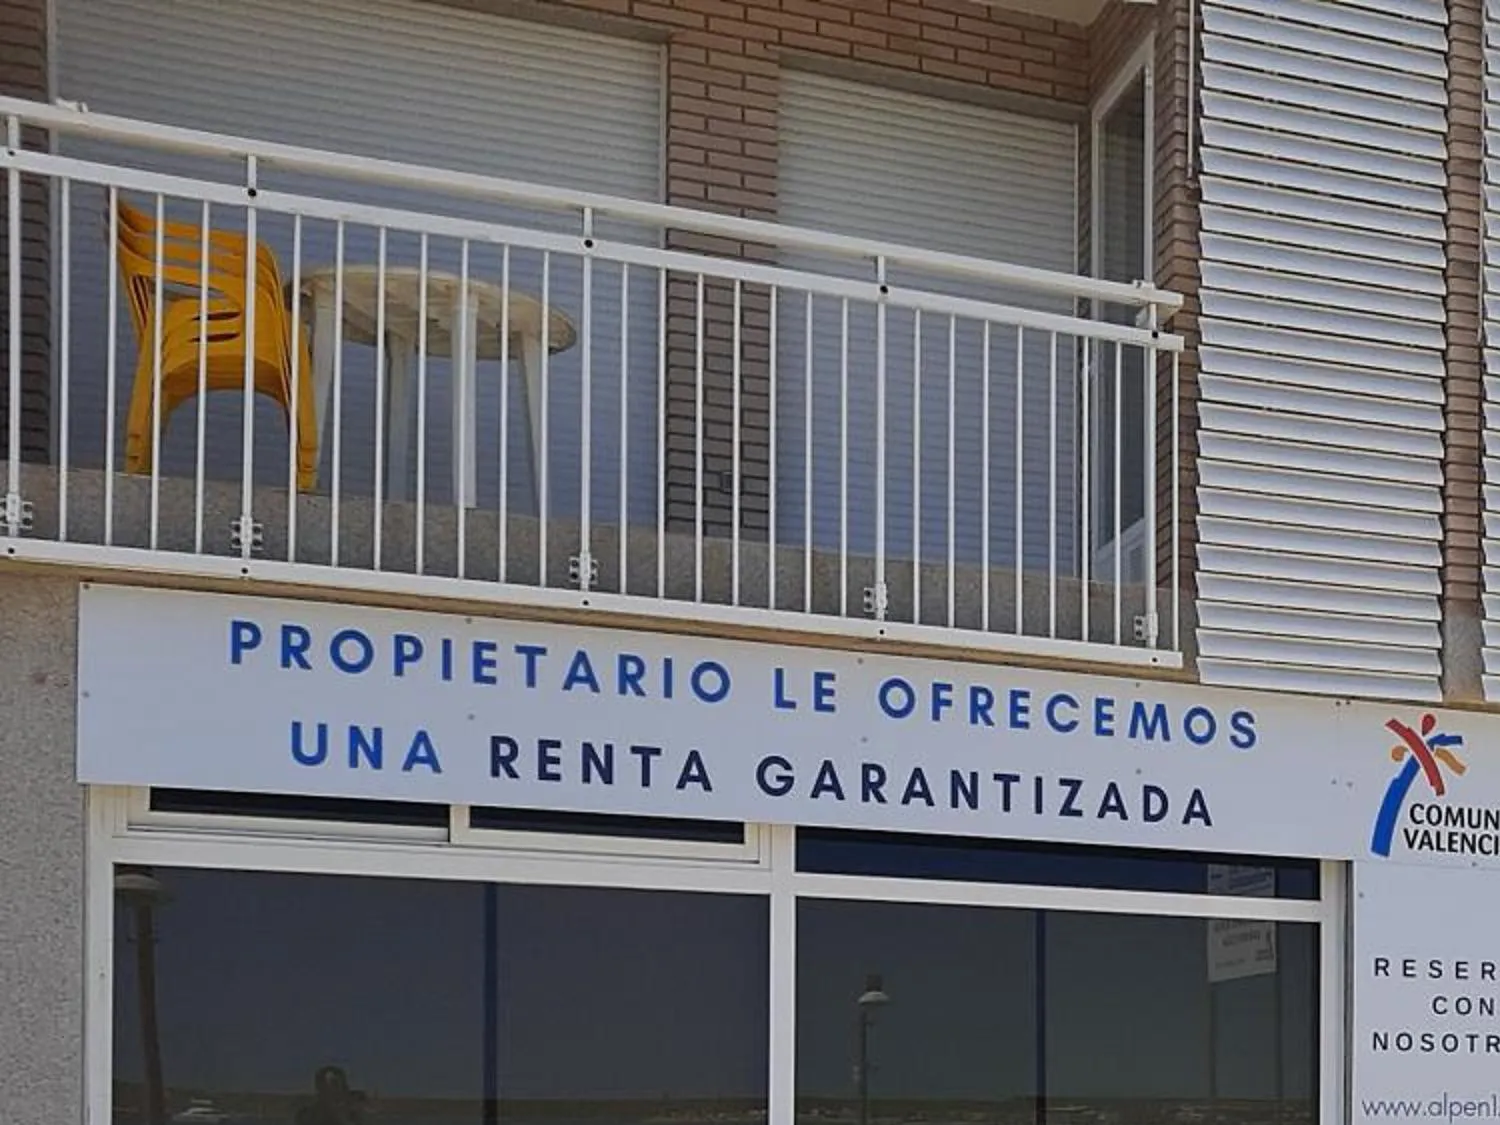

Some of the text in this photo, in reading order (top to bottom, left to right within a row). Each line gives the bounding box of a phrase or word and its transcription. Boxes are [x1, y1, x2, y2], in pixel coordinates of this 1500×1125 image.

[230, 619, 1257, 750] PROPIETARIO LE OFRECEMOS
[291, 720, 1213, 827] UNA RENTA GARANTIZADA
[1432, 996, 1495, 1016] CON
